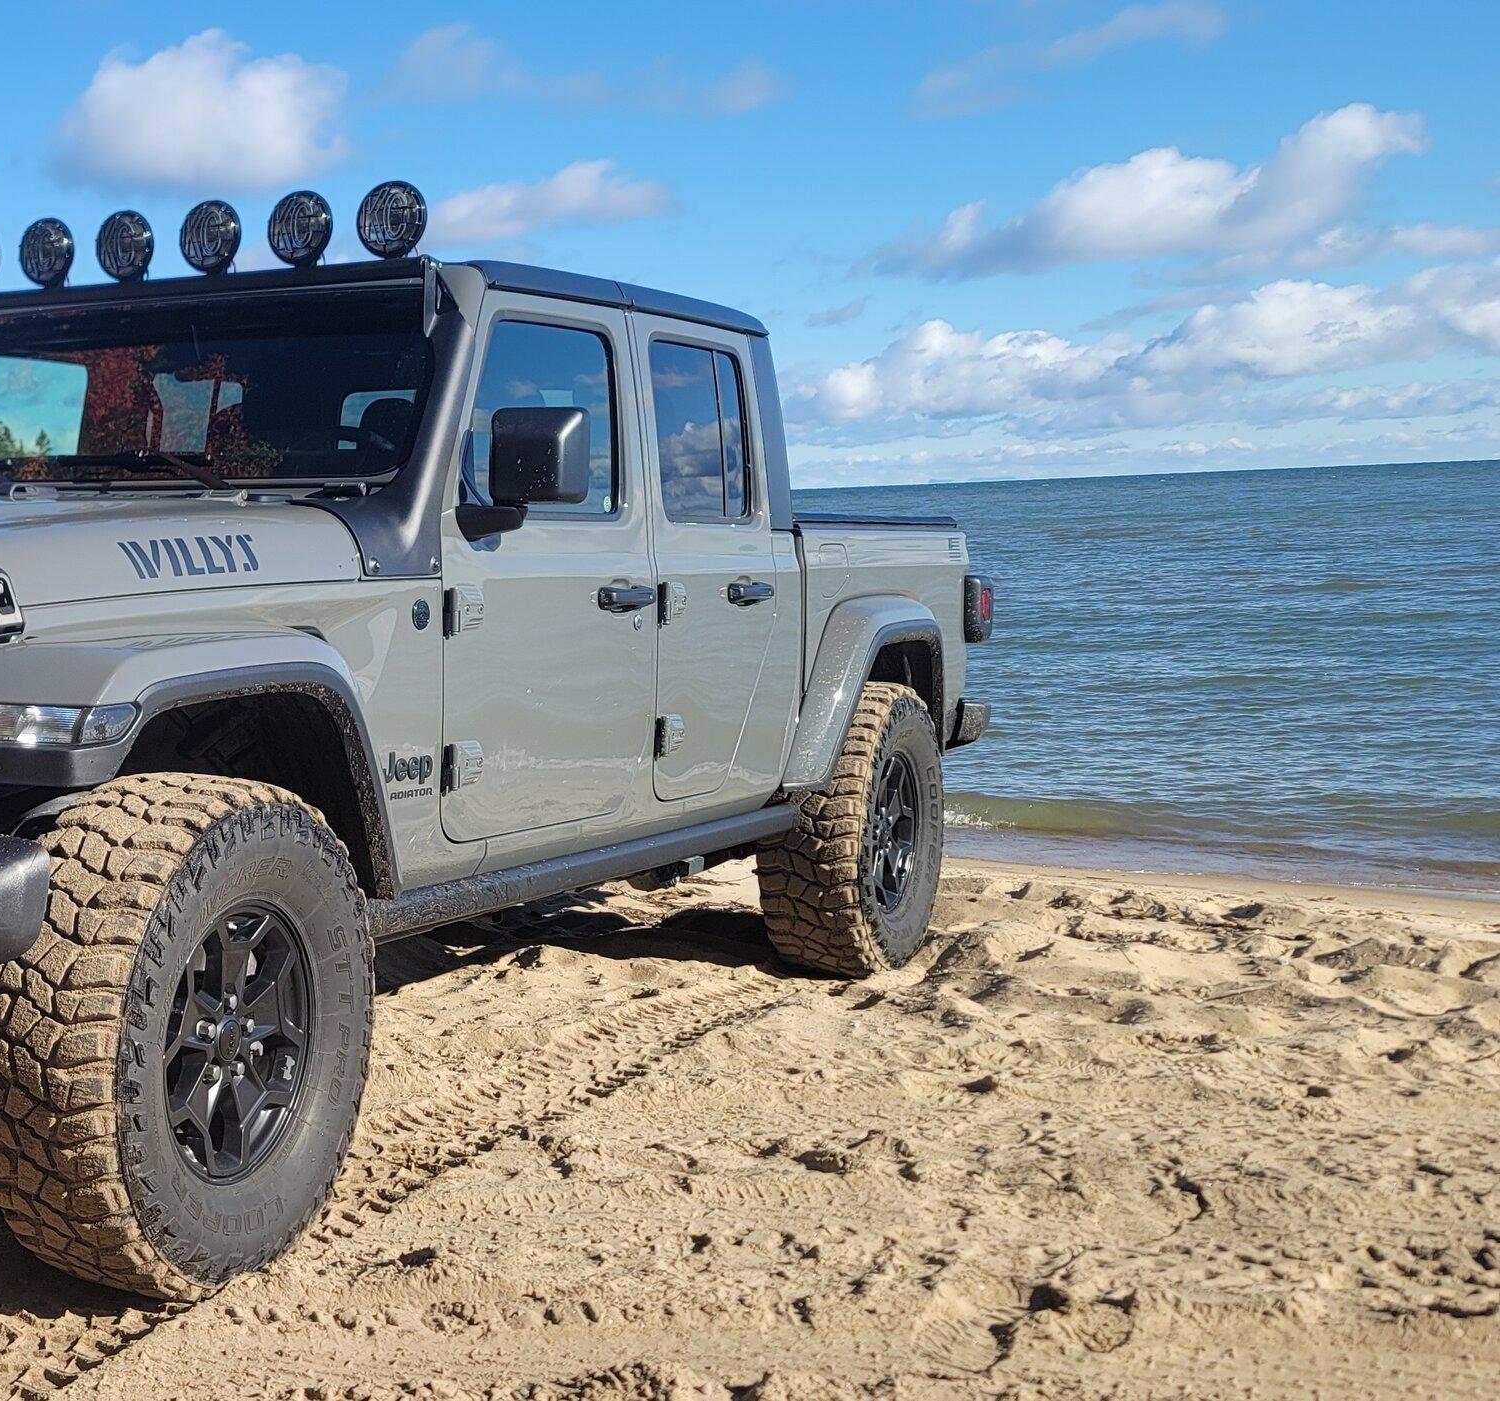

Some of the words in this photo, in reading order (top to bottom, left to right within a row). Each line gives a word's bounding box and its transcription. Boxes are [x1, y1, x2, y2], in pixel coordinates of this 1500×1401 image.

[183, 207, 222, 260] KC
[272, 196, 313, 252] KC
[363, 186, 408, 246] KC
[100, 217, 135, 273] KC
[117, 534, 259, 579] WILLYS
[382, 751, 433, 785] Jeep
[390, 787, 433, 801] ADIATOR
[327, 925, 356, 1015] STT
[328, 1022, 351, 1107] PRO
[171, 1170, 284, 1237] COOPER
